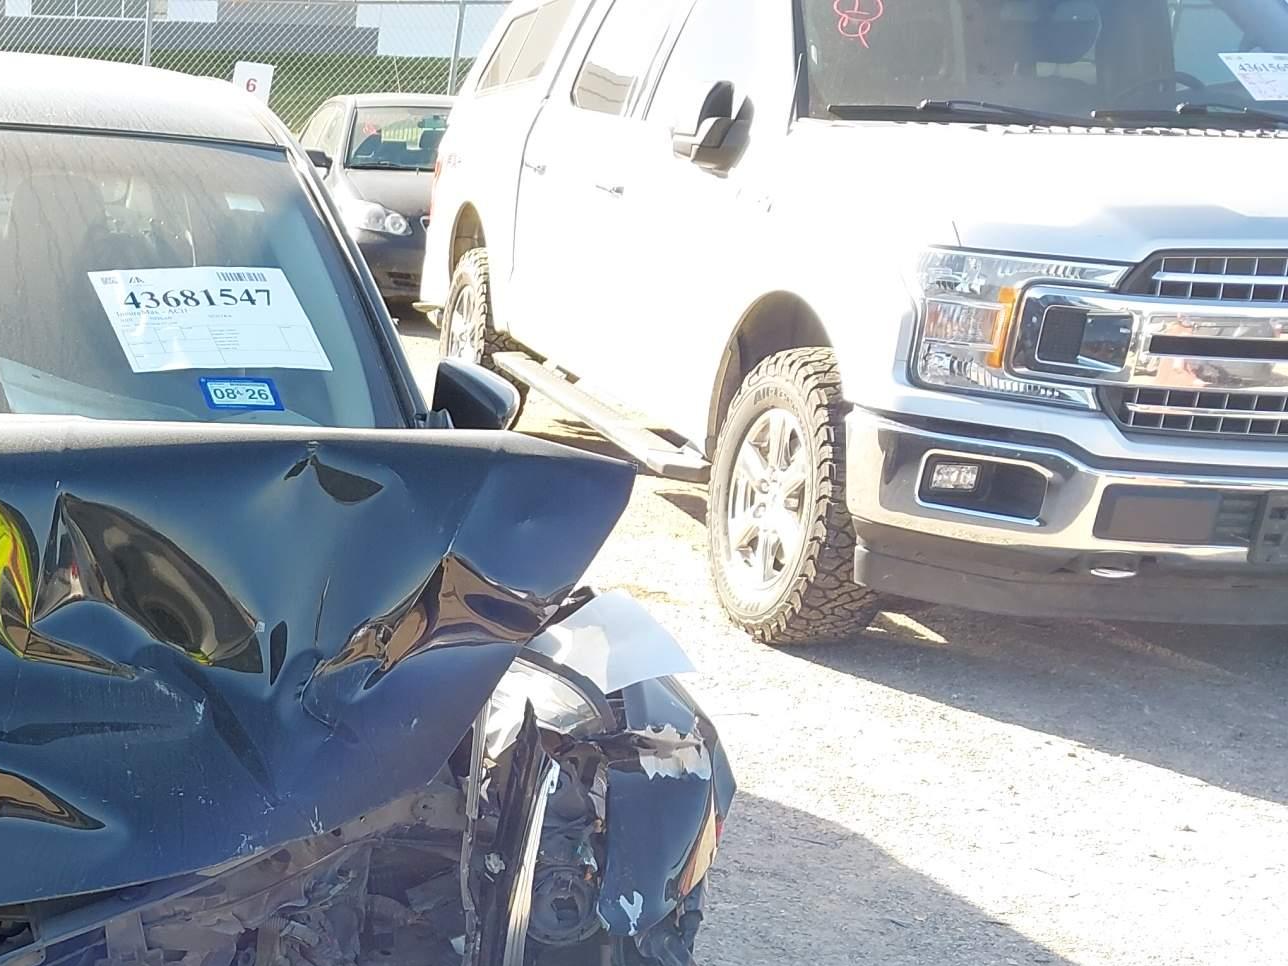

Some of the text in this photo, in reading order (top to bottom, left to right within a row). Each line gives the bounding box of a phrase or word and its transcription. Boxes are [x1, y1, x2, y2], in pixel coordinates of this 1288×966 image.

[246, 77, 257, 93] 6
[123, 288, 272, 310] 43681547
[213, 388, 269, 401] 08 26
